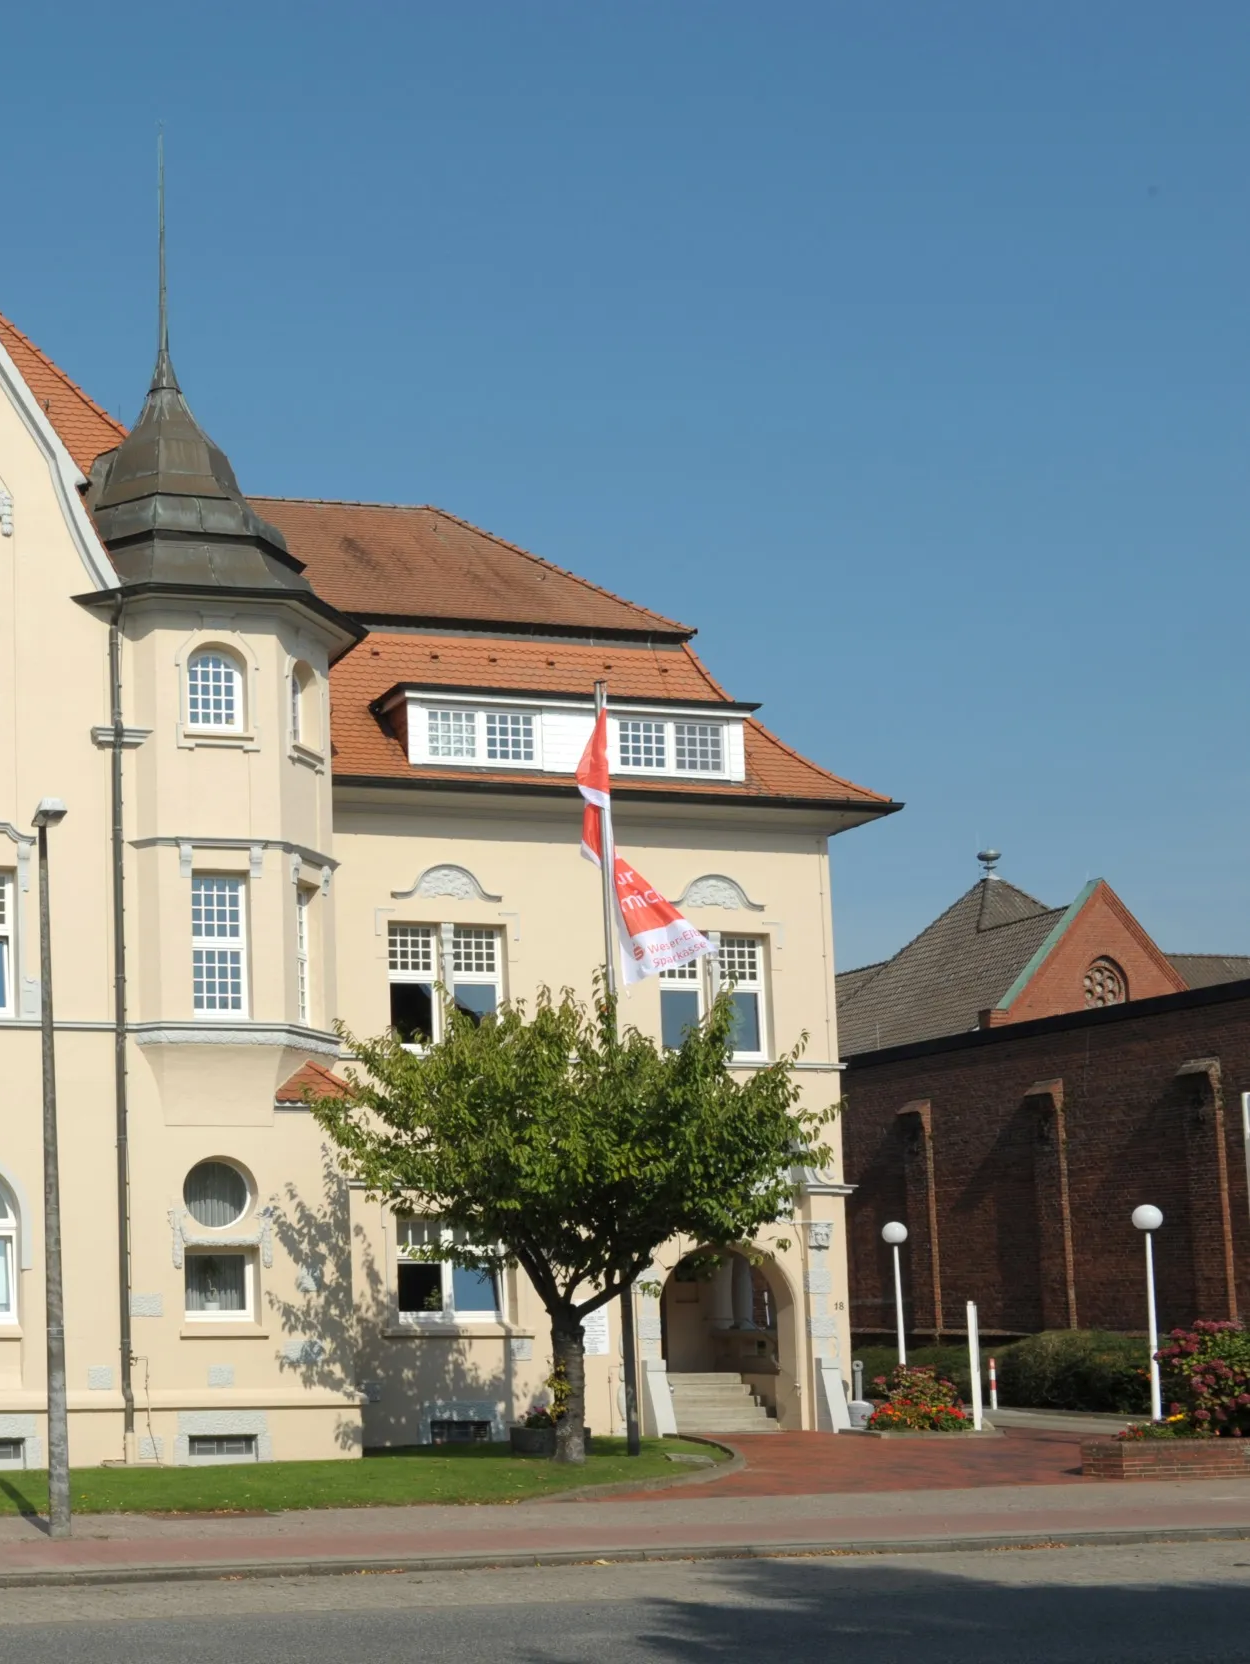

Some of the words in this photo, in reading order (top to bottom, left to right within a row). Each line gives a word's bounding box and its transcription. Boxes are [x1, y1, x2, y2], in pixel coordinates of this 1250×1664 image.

[647, 929, 701, 955] Weser-Elb
[653, 942, 707, 968] Sparkasse
[834, 1301, 845, 1311] 18
